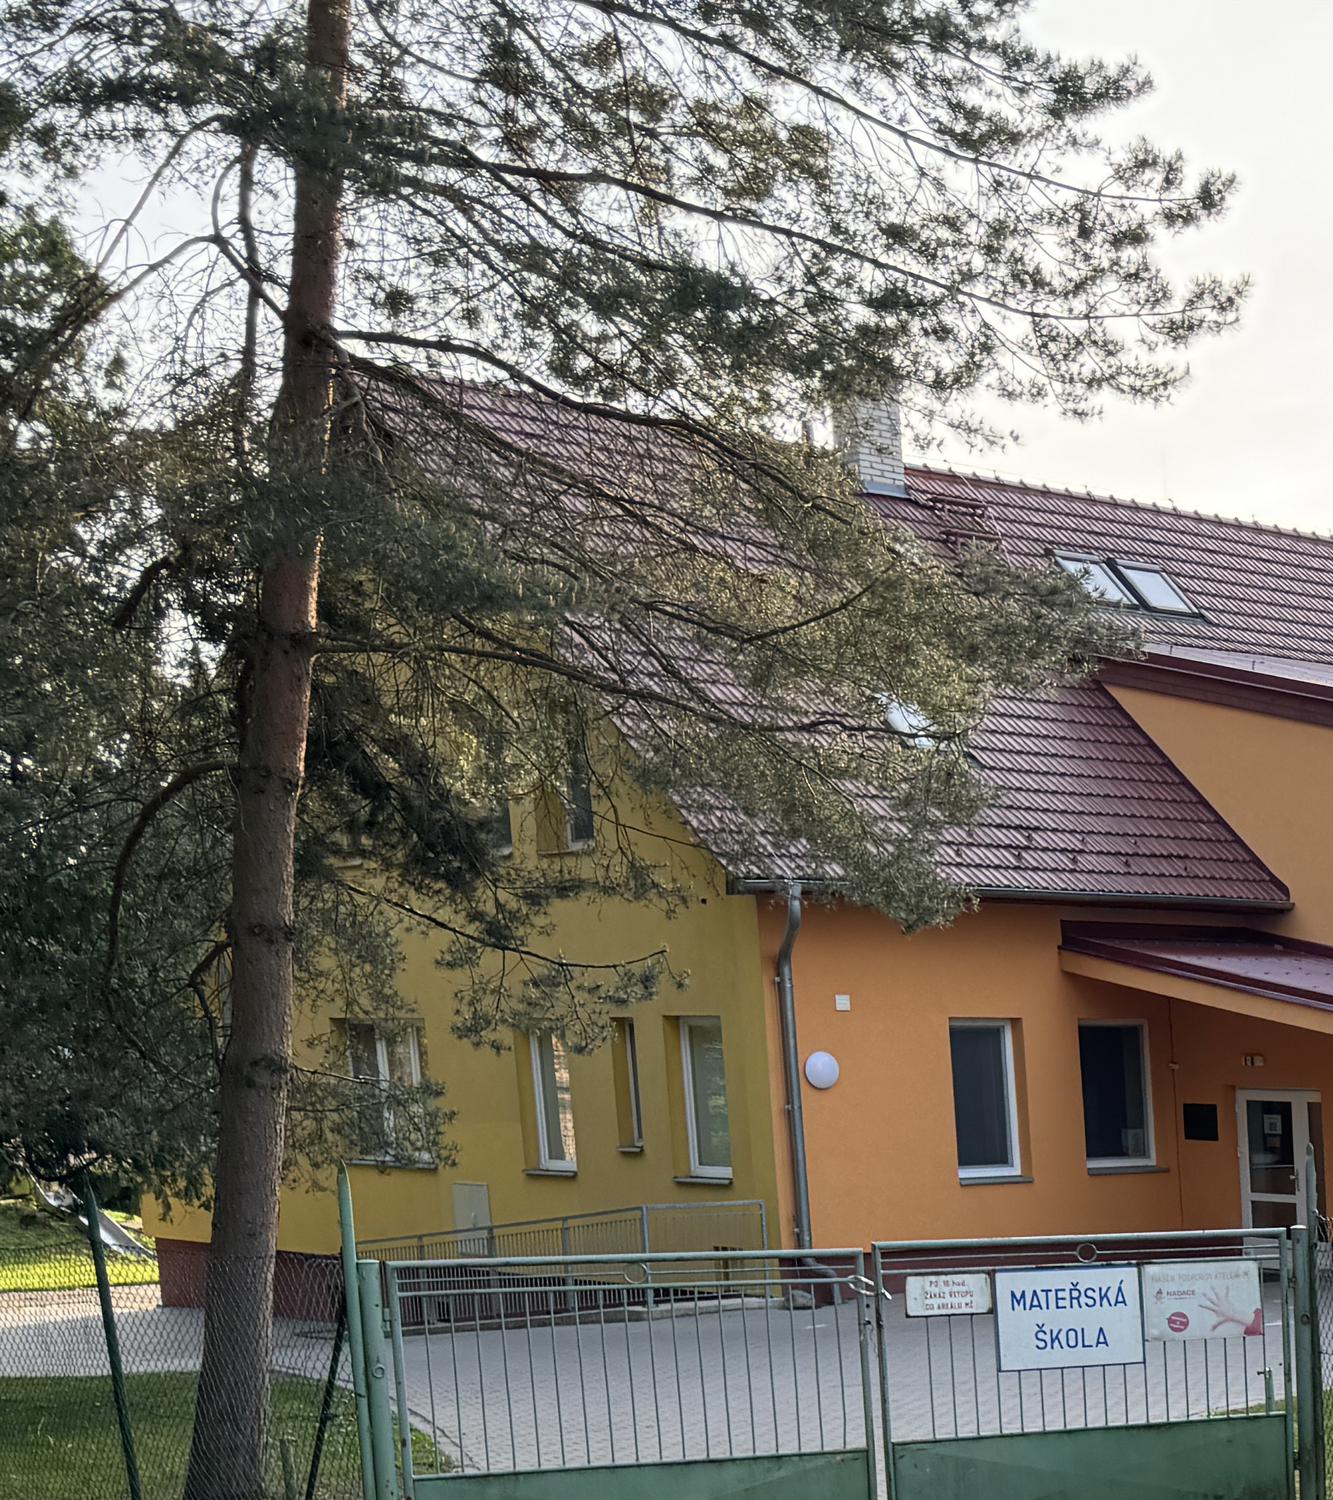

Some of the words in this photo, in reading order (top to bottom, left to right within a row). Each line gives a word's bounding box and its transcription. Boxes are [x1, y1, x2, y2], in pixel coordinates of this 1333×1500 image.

[1010, 1279, 1128, 1312] MATEŘSKÁ
[1166, 1289, 1196, 1297] NADACE
[1034, 1323, 1109, 1351] ŠKOLA
